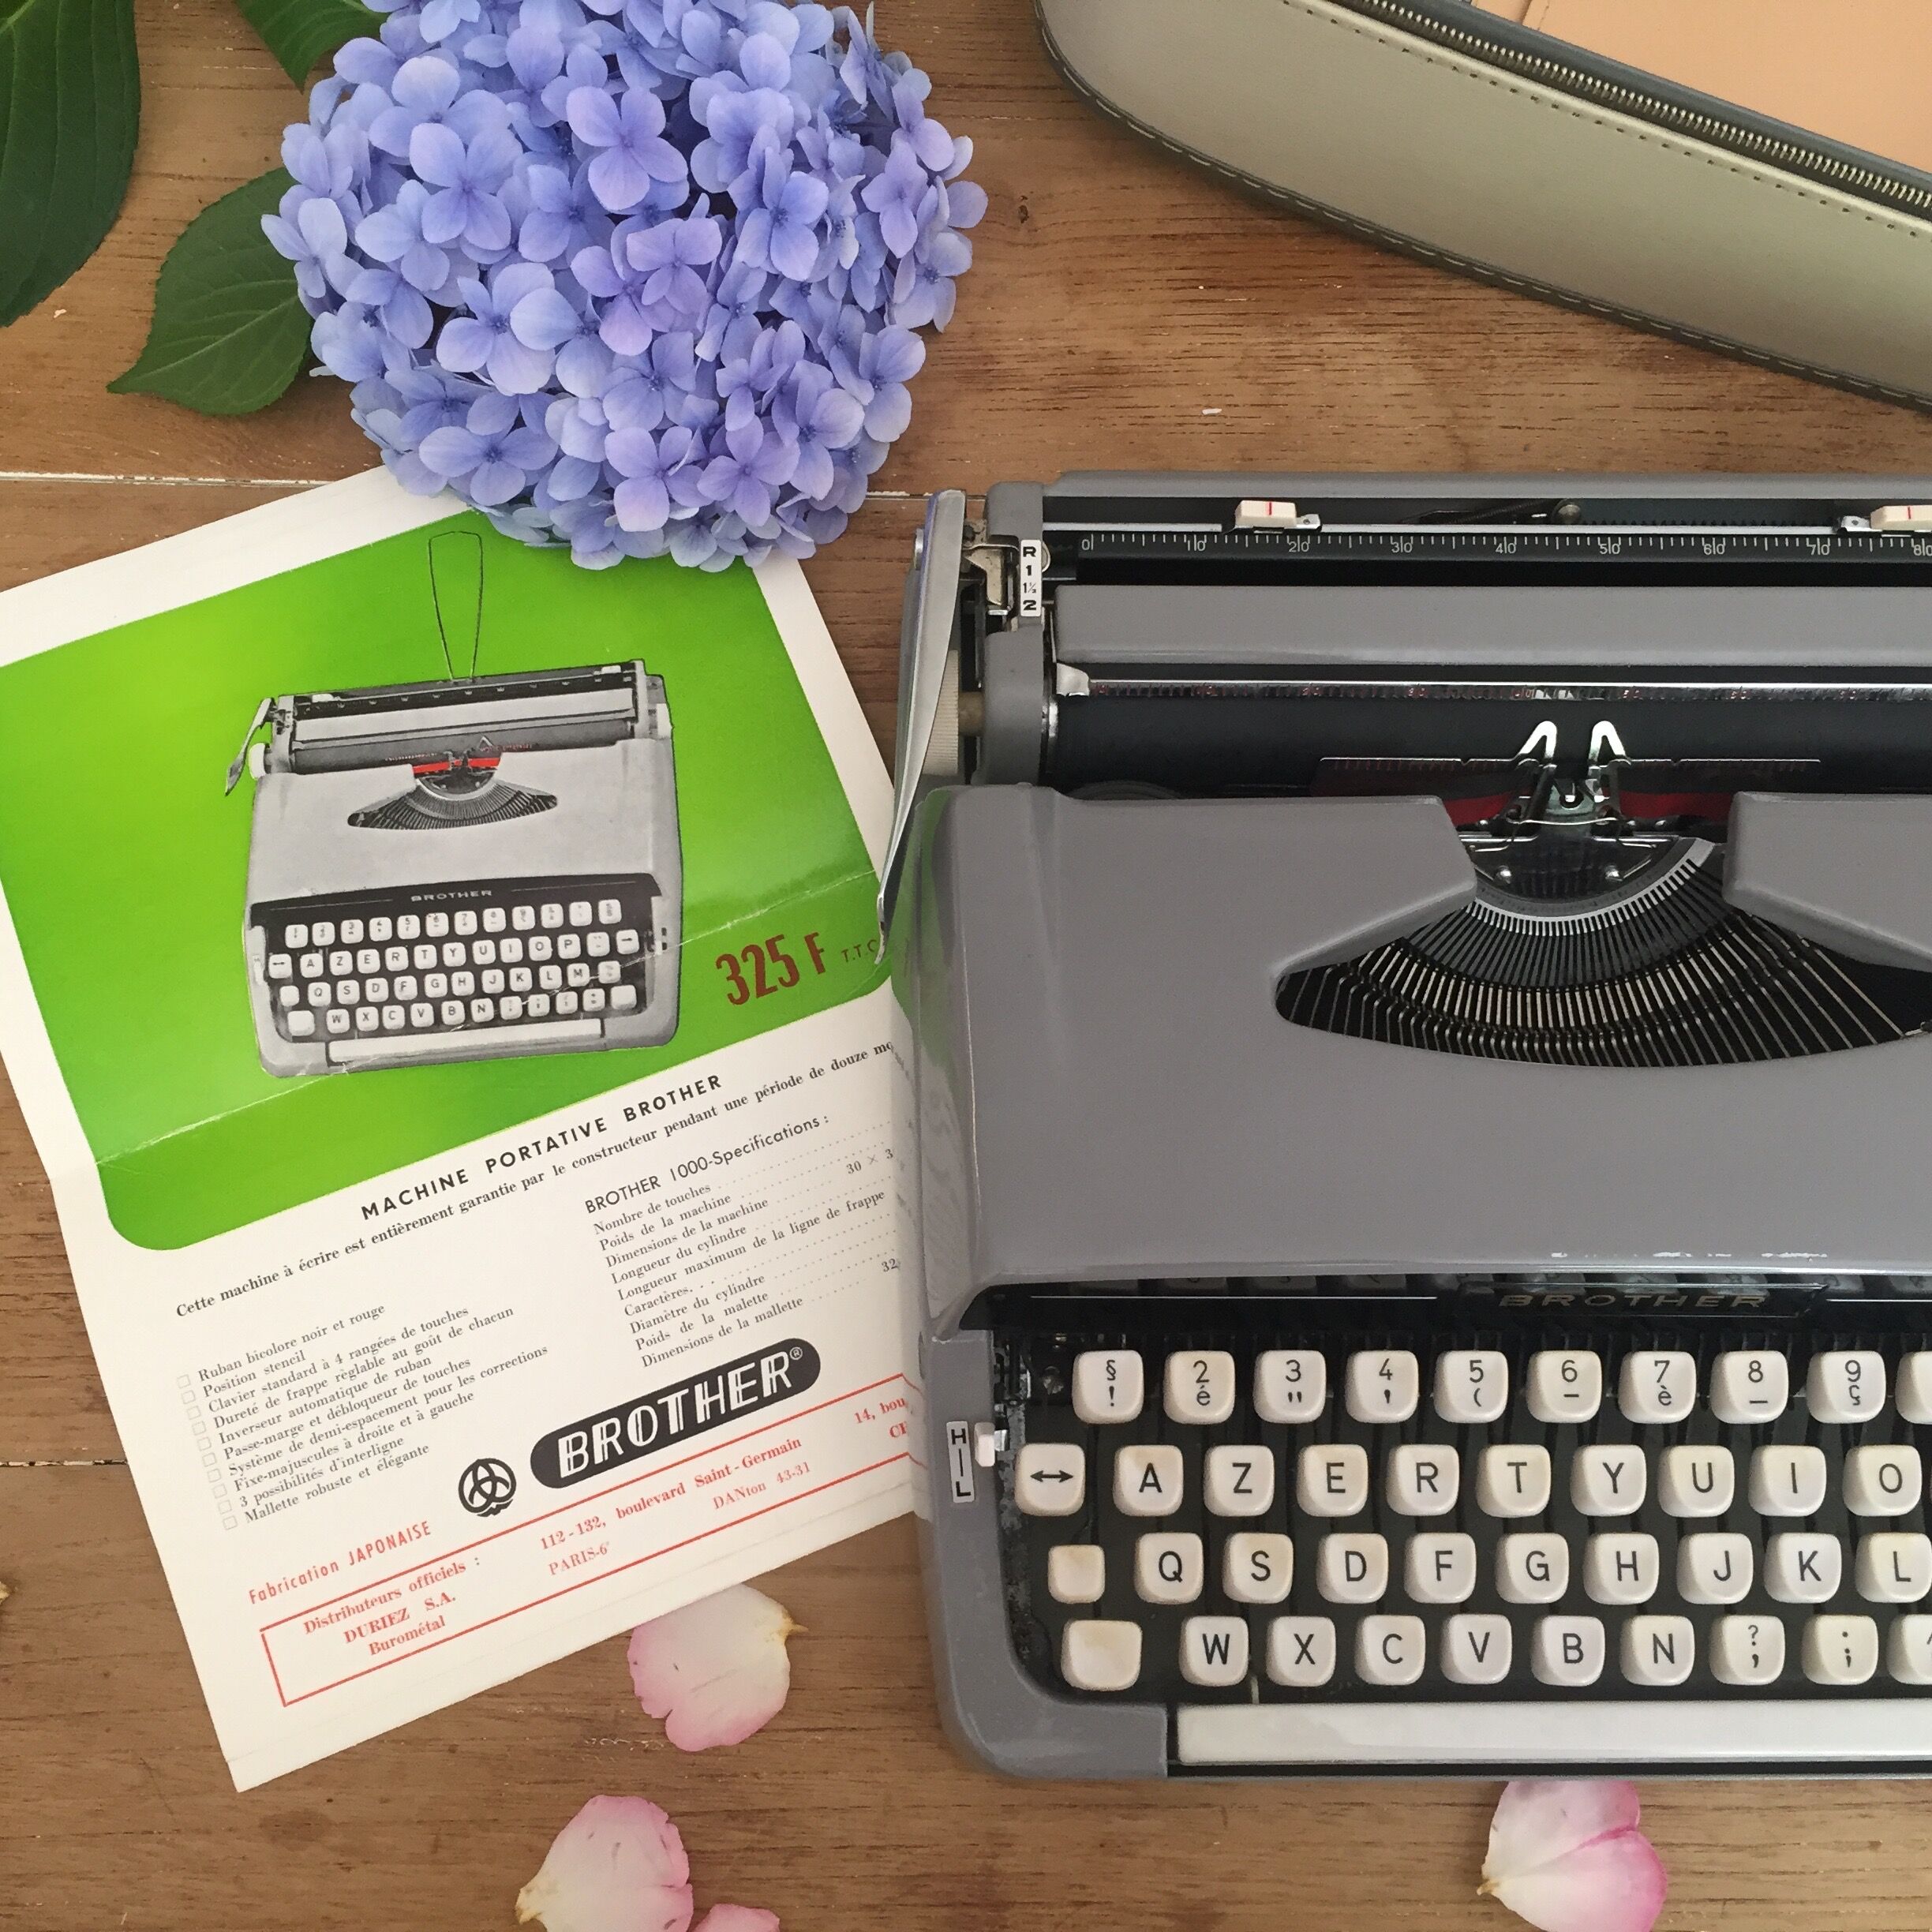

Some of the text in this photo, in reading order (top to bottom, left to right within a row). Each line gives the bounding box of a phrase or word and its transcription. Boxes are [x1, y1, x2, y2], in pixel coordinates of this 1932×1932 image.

[1023, 546, 1037, 557] R
[1026, 565, 1032, 576] 1
[1082, 539, 1089, 550] 0
[1023, 600, 1037, 611] 2
[410, 890, 492, 901] BROTHER
[715, 934, 800, 1005] 325
[804, 931, 826, 975] F
[361, 1076, 722, 1221] MACHINE PORTATIVE BROTHER
[176, 1050, 869, 1317] Cette machine écrire est entièrement garantie par le constructeur pendant une période de douze
[584, 1175, 661, 1214] BROTHER
[593, 1185, 711, 1235] Nombre de touches
[598, 1195, 731, 1252] Poids de la machine
[605, 1200, 769, 1268] Dimensions de la machine
[617, 1192, 885, 1301] Longueur maximum de la ligne de frappe
[611, 1226, 747, 1285] Longueur du cylindre
[629, 1275, 765, 1335] Diamètre du cylindre
[635, 1293, 769, 1351] Poids de la malette
[1500, 1294, 1766, 1307] BROTHER
[197, 1305, 385, 1383] Ruban bicolore noir et rouge
[208, 1309, 469, 1413] Clavier standard rangées de touches
[641, 1297, 803, 1368] Dimensions de la mallette
[202, 1350, 306, 1398] Position stencil
[213, 1309, 515, 1429] Dureté de frappe au goût de chacun
[218, 1357, 432, 1444] Inverseur automatique de ruban
[223, 1359, 471, 1460] Passe-marge et débloqueur de touches
[228, 1346, 548, 1477] Système de demi-espacement pour les corrections
[234, 1392, 474, 1492] Fixe-majuscules droite et gauche
[951, 1428, 966, 1444] H
[239, 1495, 248, 1507] 3
[253, 1469, 324, 1506] possibilités
[244, 1445, 429, 1523] Mallette robuste et élégante
[615, 1481, 687, 1520] boulevard
[713, 1482, 767, 1510] DANton
[956, 1481, 971, 1496] L
[1139, 1462, 1902, 1493] A Z E R T Y U O
[248, 1522, 431, 1604] Fabrication JAPONAISE
[1159, 1551, 1911, 1582] Q S D F G H J K L
[302, 1562, 467, 1635] Distributeurs officiels
[343, 1592, 456, 1644] DURIEZ S.A.
[368, 1615, 446, 1656] Burométal
[1203, 1632, 1675, 1664] W X C V B N
